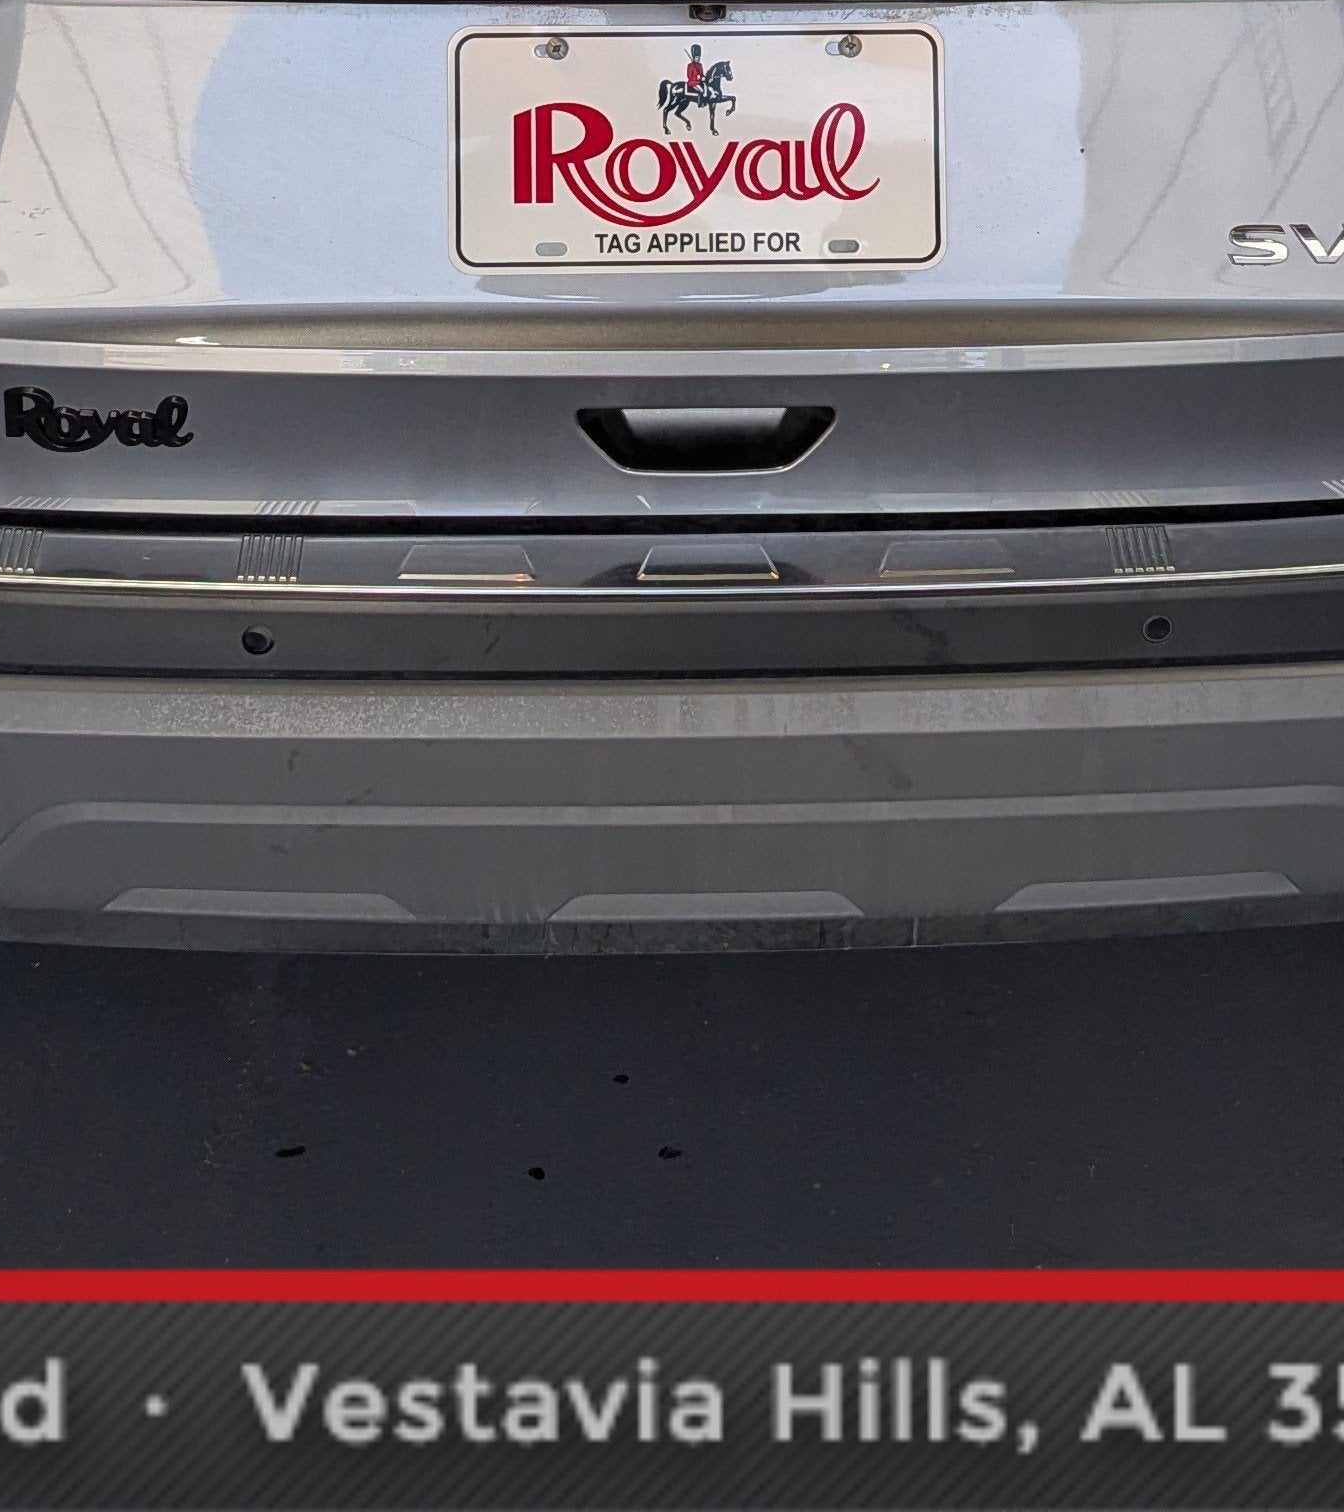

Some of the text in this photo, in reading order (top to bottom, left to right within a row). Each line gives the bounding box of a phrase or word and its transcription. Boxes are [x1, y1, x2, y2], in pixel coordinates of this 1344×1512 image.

[513, 102, 881, 228] Royal
[594, 232, 801, 255] TAG APPLIED FOR
[3, 386, 195, 453] Royal
